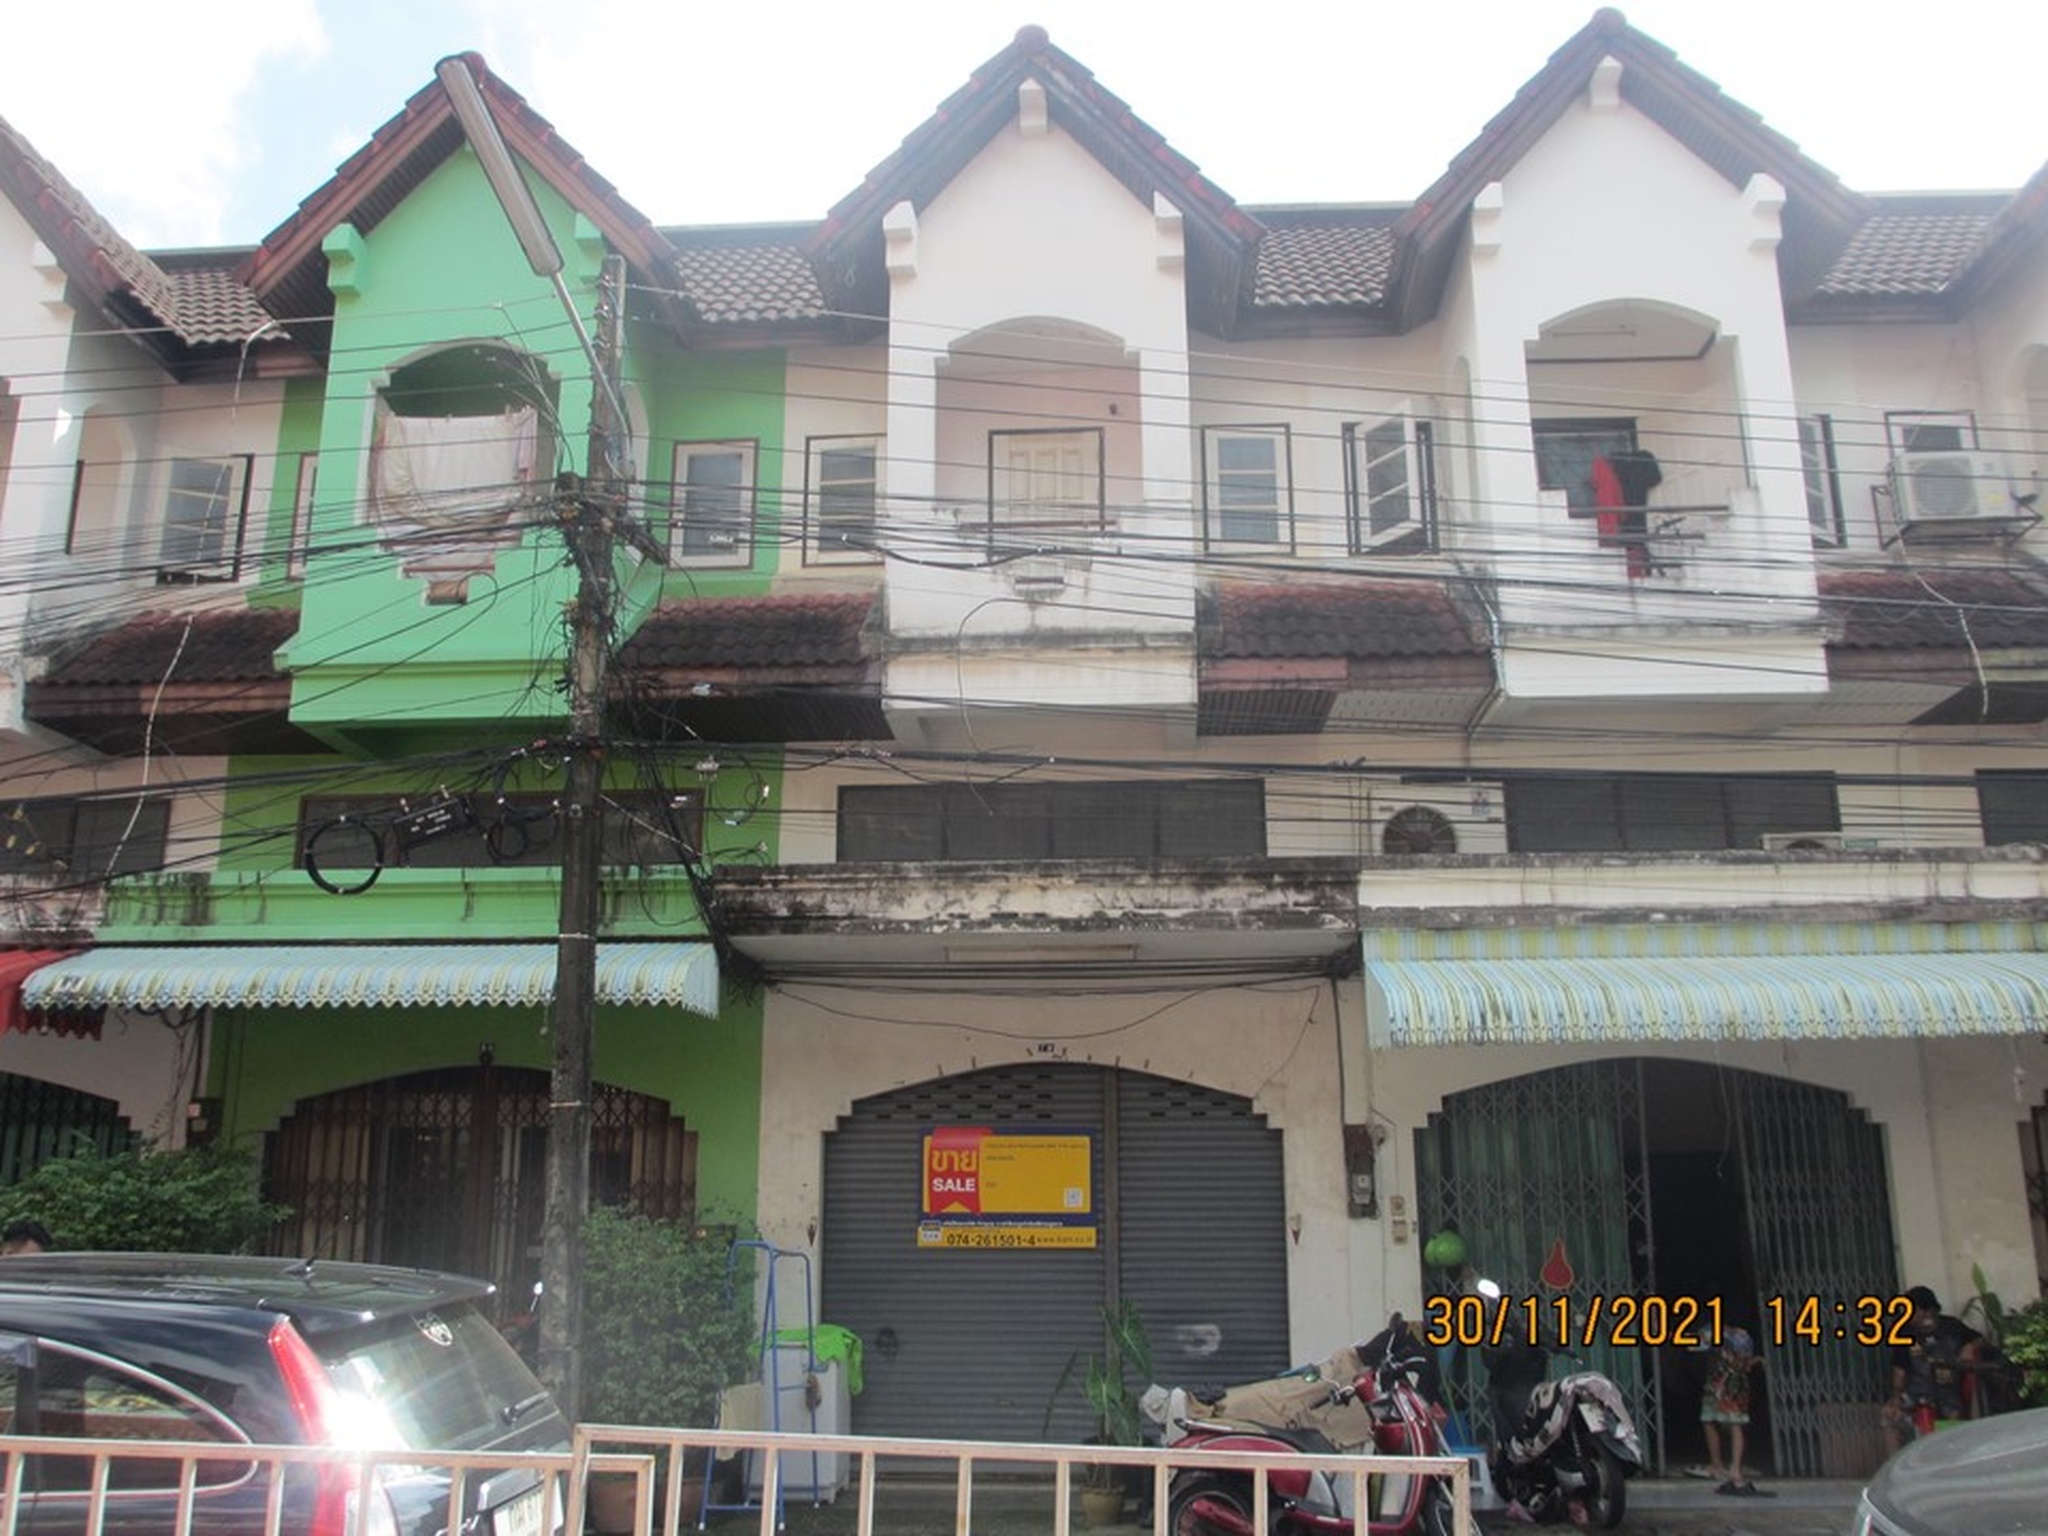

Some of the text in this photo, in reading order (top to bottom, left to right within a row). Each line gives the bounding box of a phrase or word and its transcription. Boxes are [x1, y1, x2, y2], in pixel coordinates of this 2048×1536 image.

[932, 1149, 977, 1172] ขาย
[932, 1178, 976, 1193] SALE
[946, 1233, 1036, 1247] 074-261501-4
